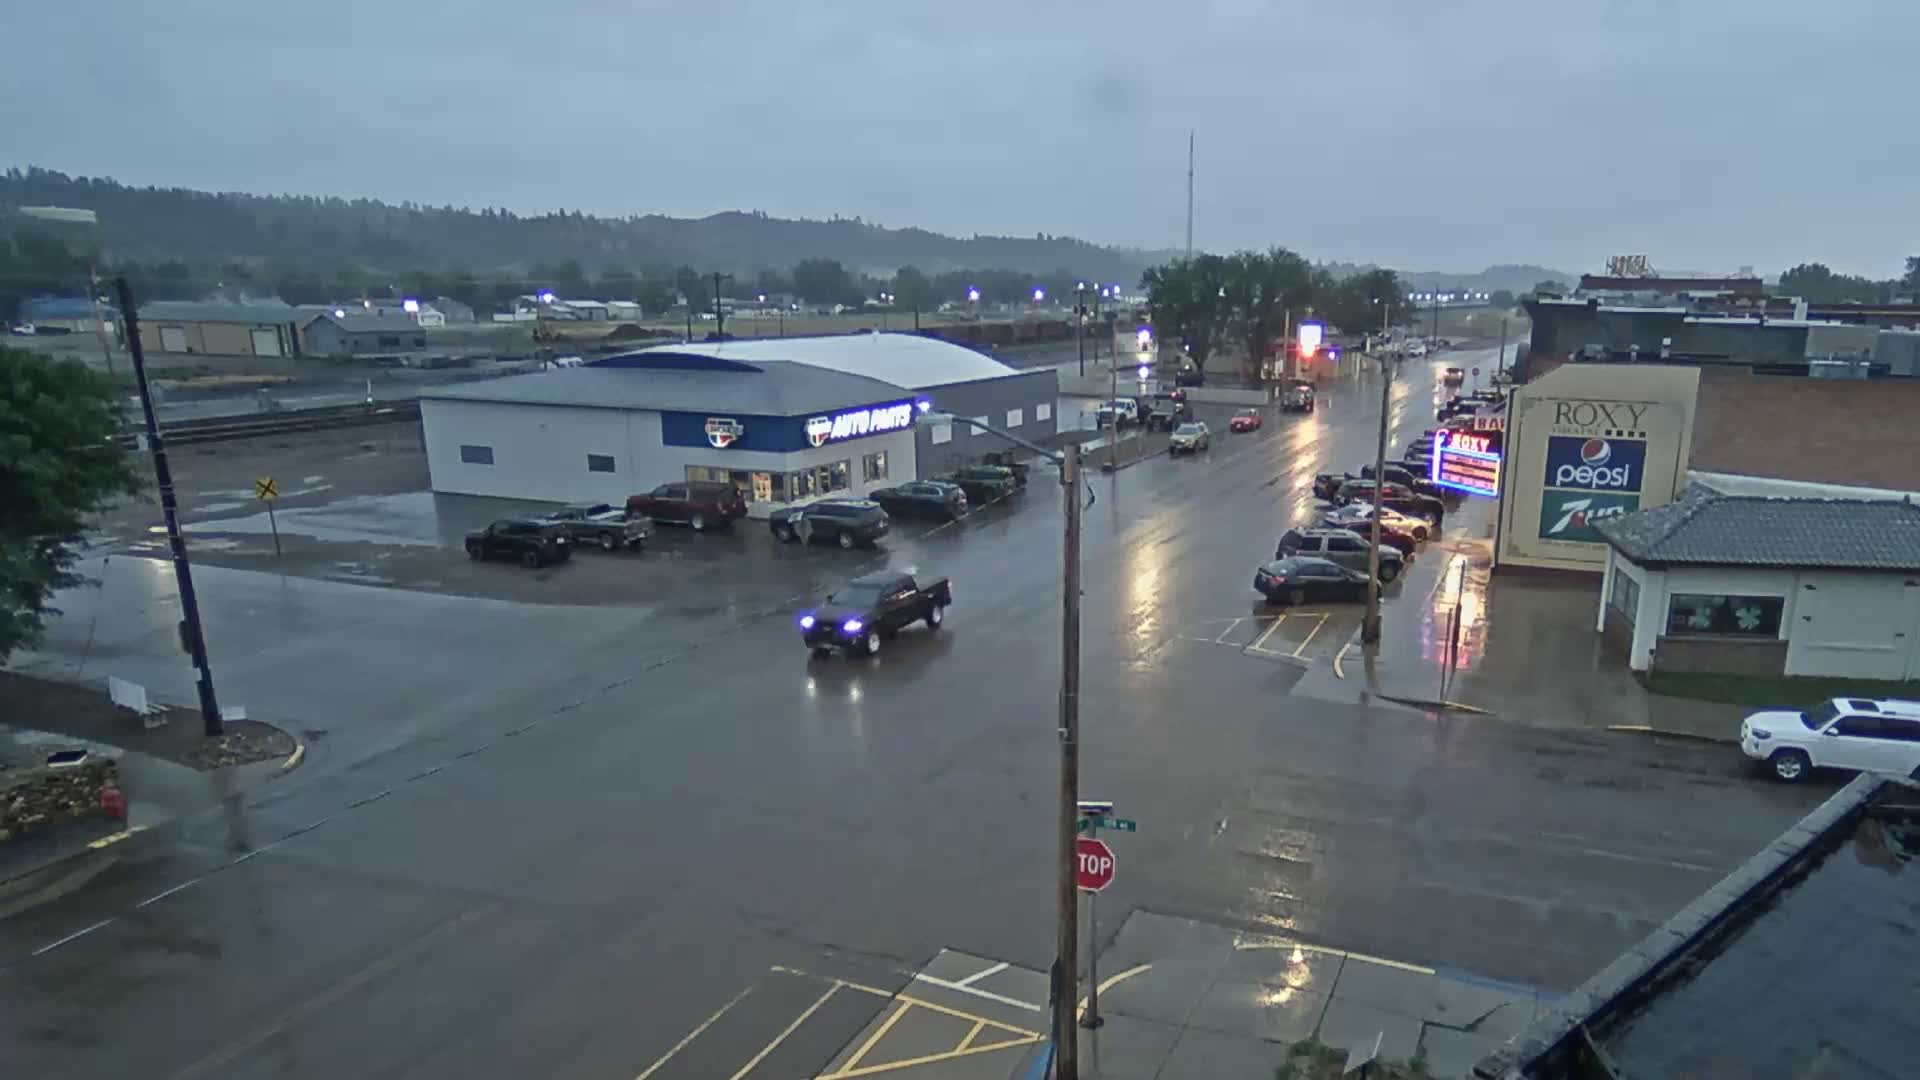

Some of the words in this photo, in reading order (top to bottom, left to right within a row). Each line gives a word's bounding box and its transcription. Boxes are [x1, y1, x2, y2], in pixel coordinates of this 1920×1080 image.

[831, 410, 870, 439] AUTO
[870, 404, 912, 432] PARTS
[1553, 402, 1647, 428] ROXY
[1556, 463, 1629, 489] pepsi
[1078, 854, 1111, 876] TOP
